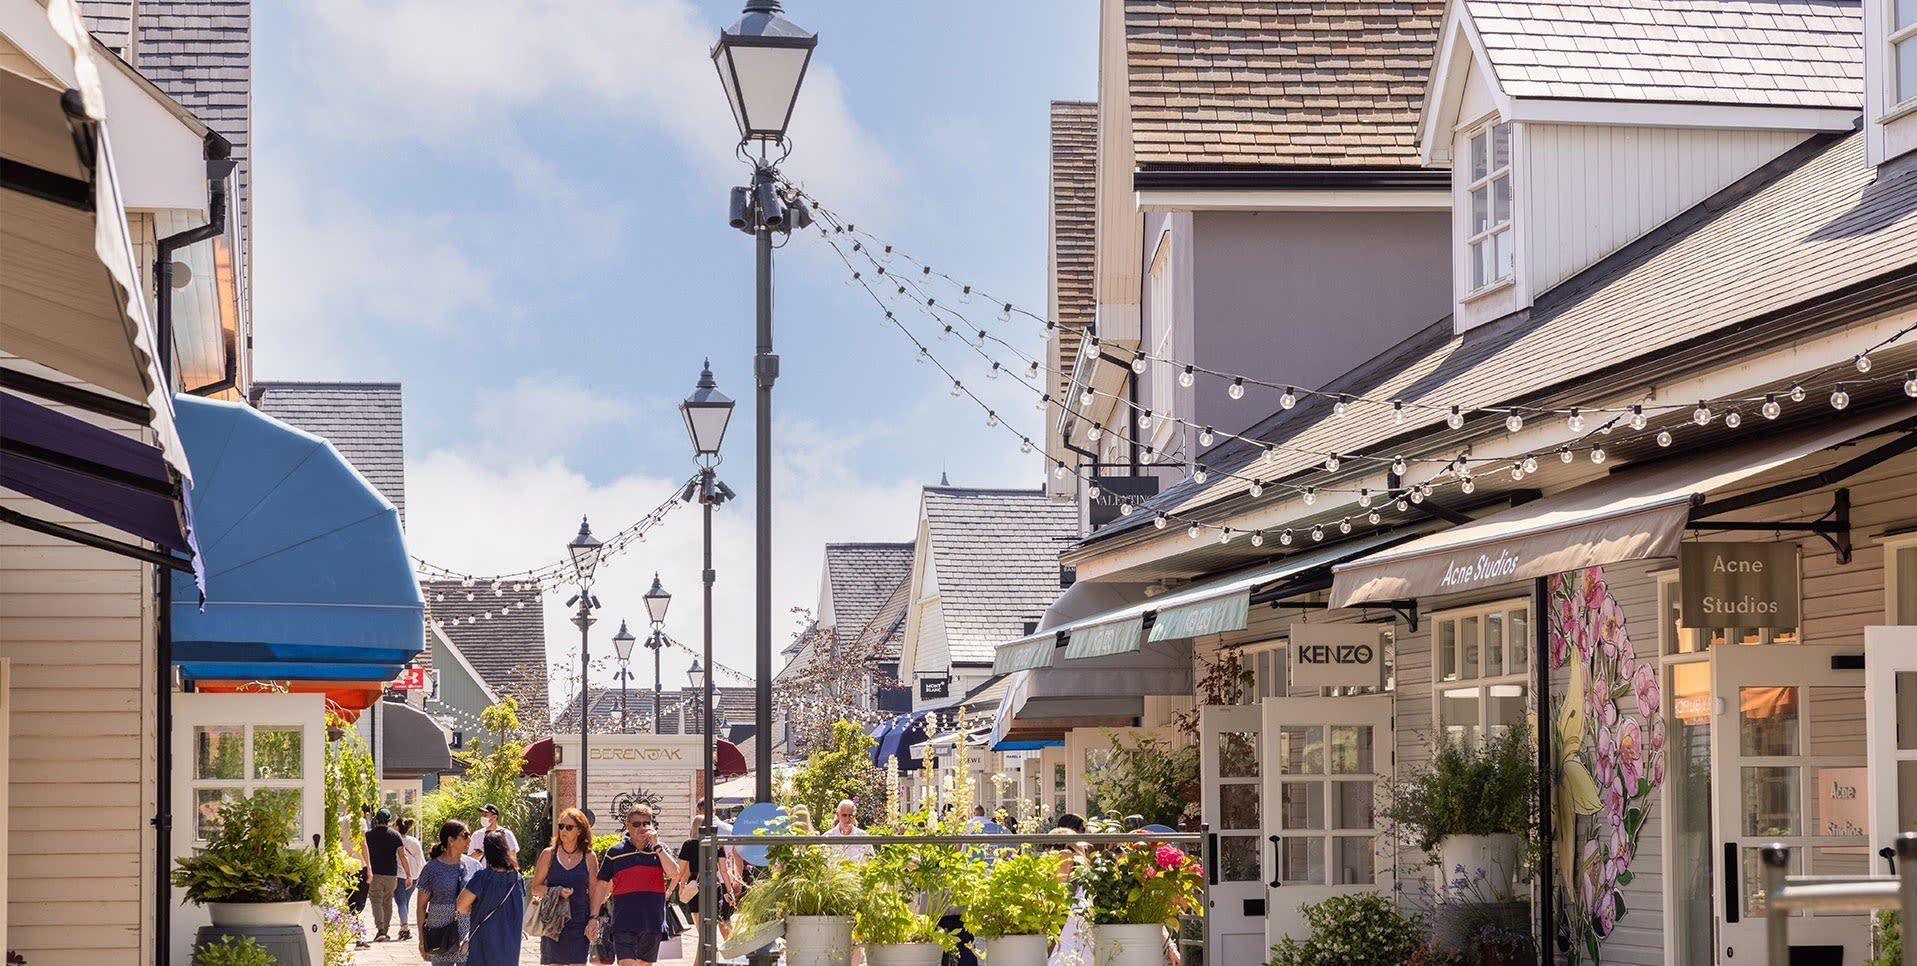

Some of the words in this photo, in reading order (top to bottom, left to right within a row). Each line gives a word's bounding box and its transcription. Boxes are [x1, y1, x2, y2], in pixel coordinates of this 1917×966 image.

[1095, 494, 1152, 506] VALETIN
[1441, 559, 1473, 587] Acne
[1473, 549, 1519, 581] Studios
[1712, 555, 1763, 573] Acne
[1702, 595, 1778, 614] Studios
[1298, 644, 1373, 664] KENZO
[590, 748, 682, 761] BERENJAK
[1831, 781, 1857, 800] Acne
